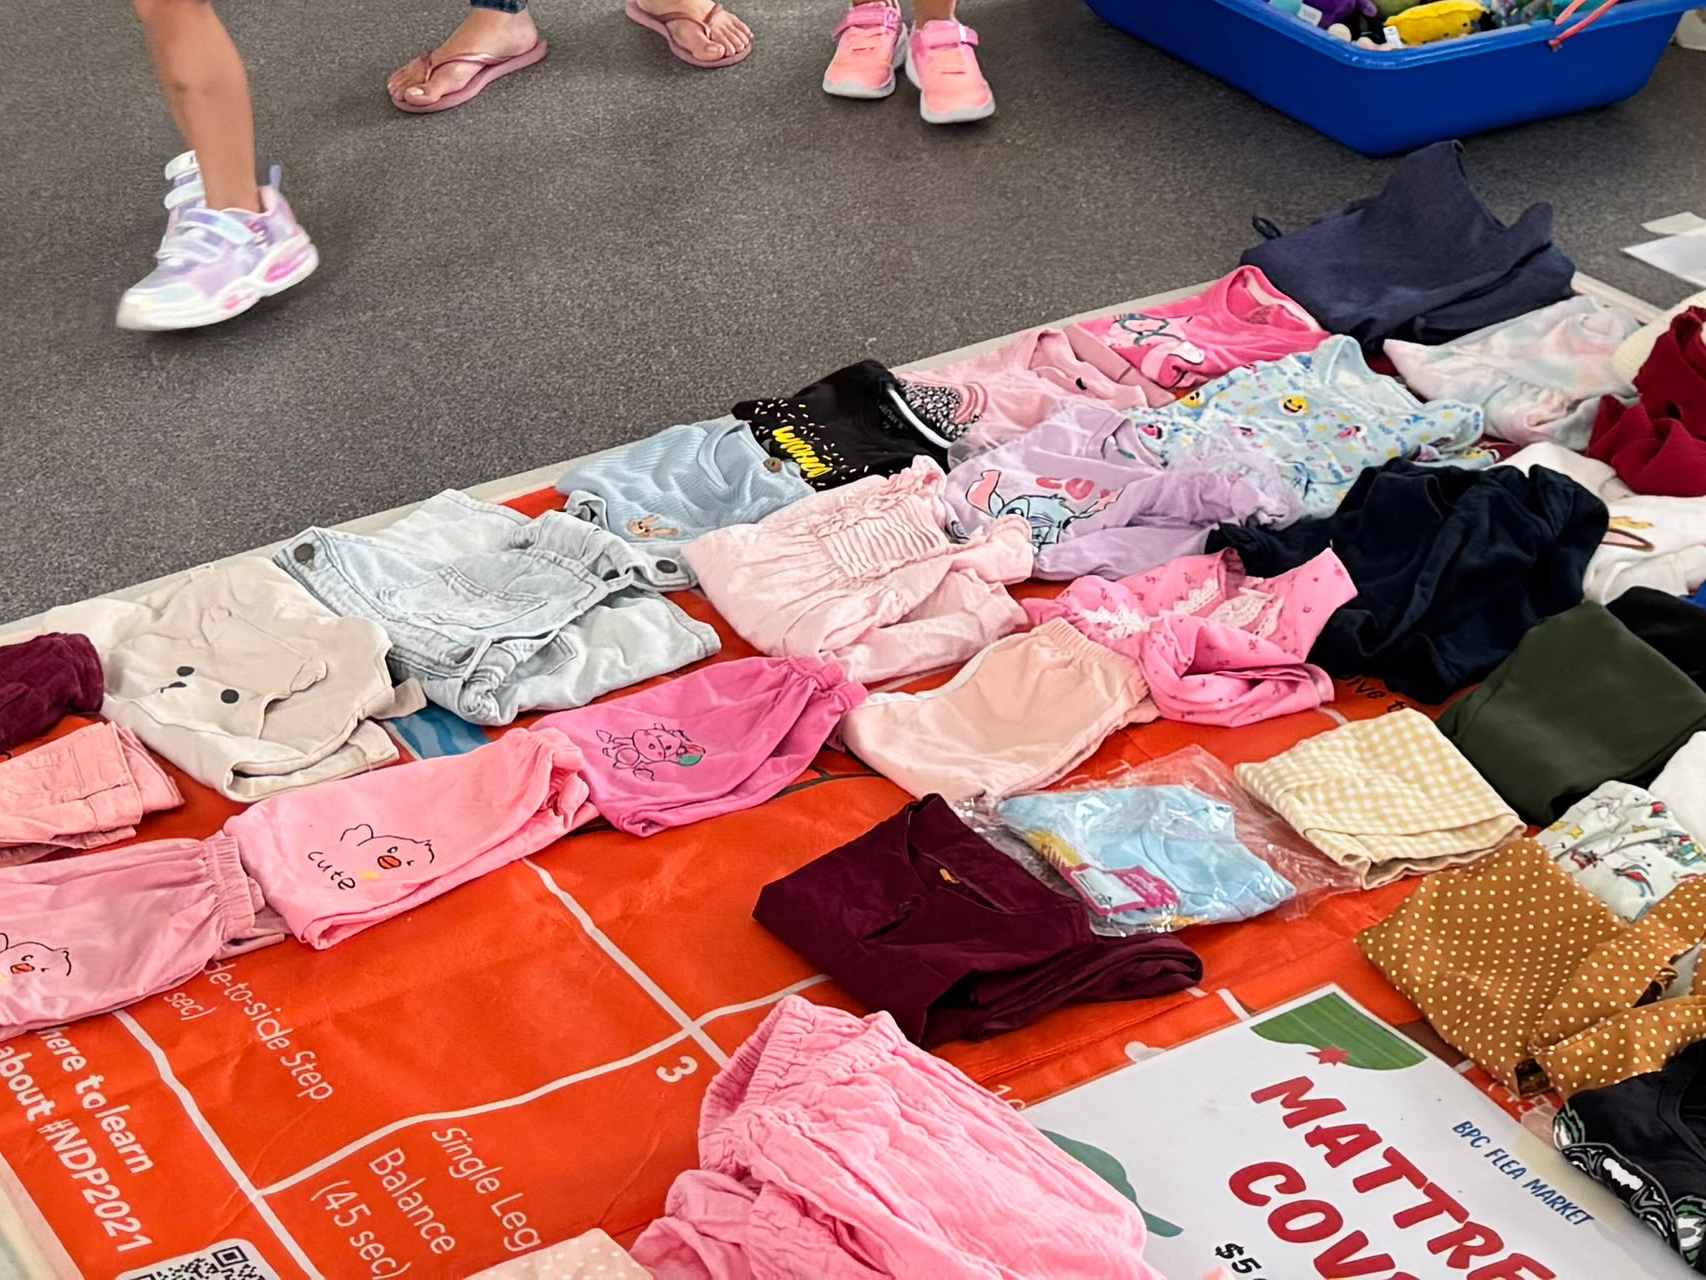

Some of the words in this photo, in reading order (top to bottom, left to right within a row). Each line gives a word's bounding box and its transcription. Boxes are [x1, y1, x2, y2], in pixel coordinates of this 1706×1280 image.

[307, 848, 358, 892] cute
[163, 991, 218, 1022] sec)
[279, 1049, 334, 1100] Step
[655, 1055, 699, 1083] 3
[74, 1073, 108, 1110] to
[94, 1103, 154, 1175] learn
[1452, 1120, 1492, 1148] BPC
[1483, 1145, 1528, 1183] FLEA
[1520, 1178, 1596, 1227] MARKET
[36, 1118, 153, 1253] #NDP2021
[309, 1179, 372, 1228] (45
[348, 1228, 413, 1280] sec)
[368, 1146, 457, 1256] Balance
[431, 1125, 504, 1196] Single
[489, 1191, 542, 1253] Leg
[1214, 1242, 1262, 1274] $5
